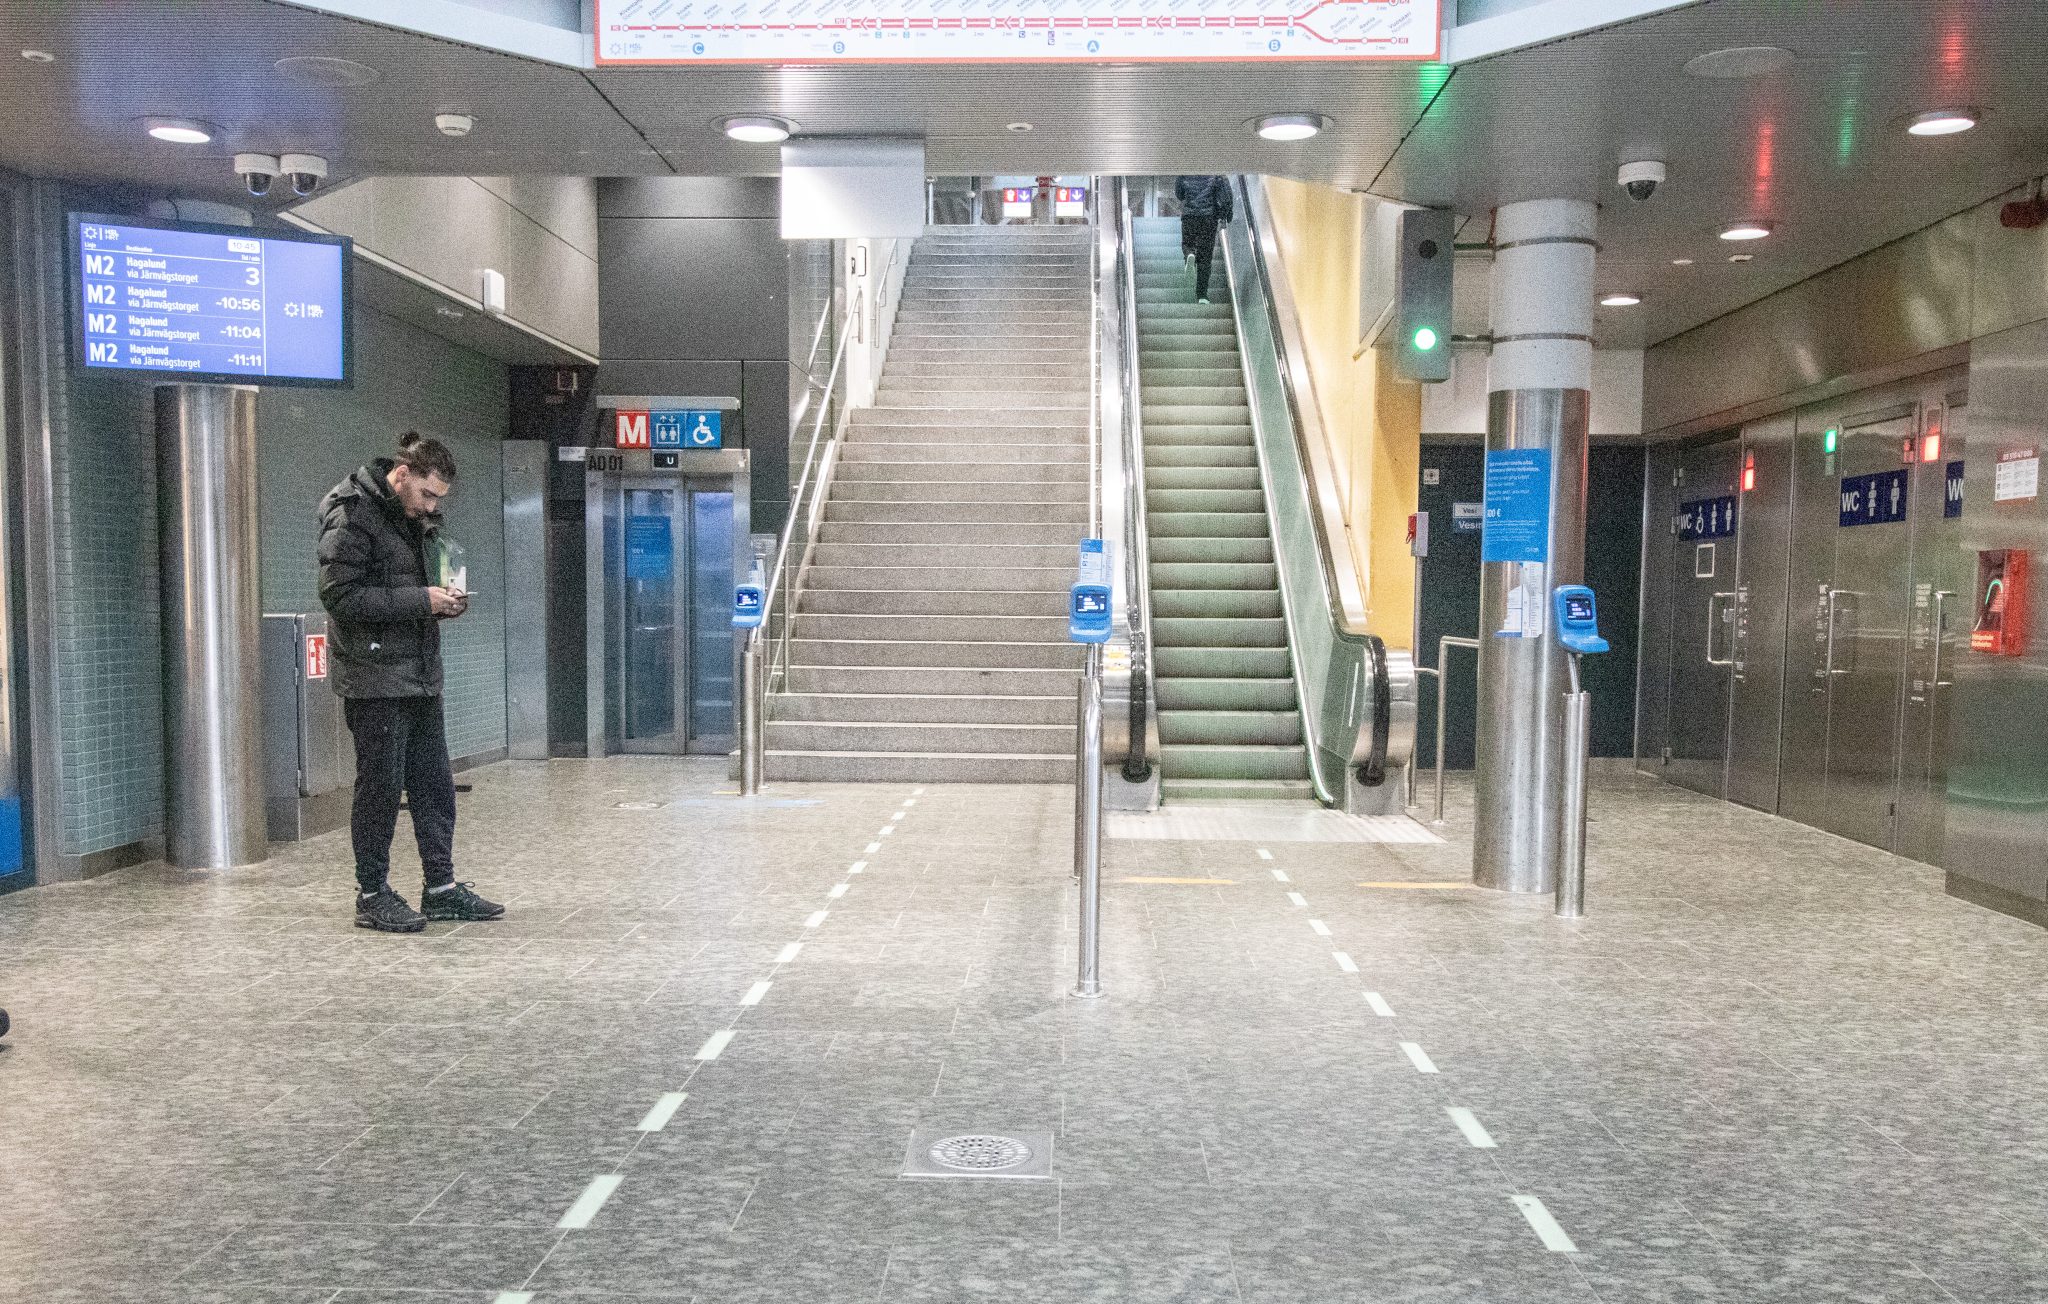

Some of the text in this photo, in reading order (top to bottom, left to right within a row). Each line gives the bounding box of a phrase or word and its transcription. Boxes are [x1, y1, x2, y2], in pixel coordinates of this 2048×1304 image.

[86, 255, 115, 276] M2
[126, 257, 166, 270] Hagalund
[127, 270, 199, 284] via Järnvägstorget
[245, 268, 260, 286] 3
[87, 285, 116, 305] M2
[127, 286, 167, 299] Hagalund
[128, 299, 200, 313] via Järnvägstorget
[88, 313, 117, 334] M2
[128, 315, 168, 328] Hagalund
[129, 328, 200, 342] via Järnvägstorget
[89, 343, 118, 363] M2
[129, 344, 169, 357] Hagalund
[130, 356, 201, 370] via Järnvägstorget
[619, 416, 647, 444] M
[1842, 491, 1859, 512] WC
[1681, 513, 1692, 530] WC
